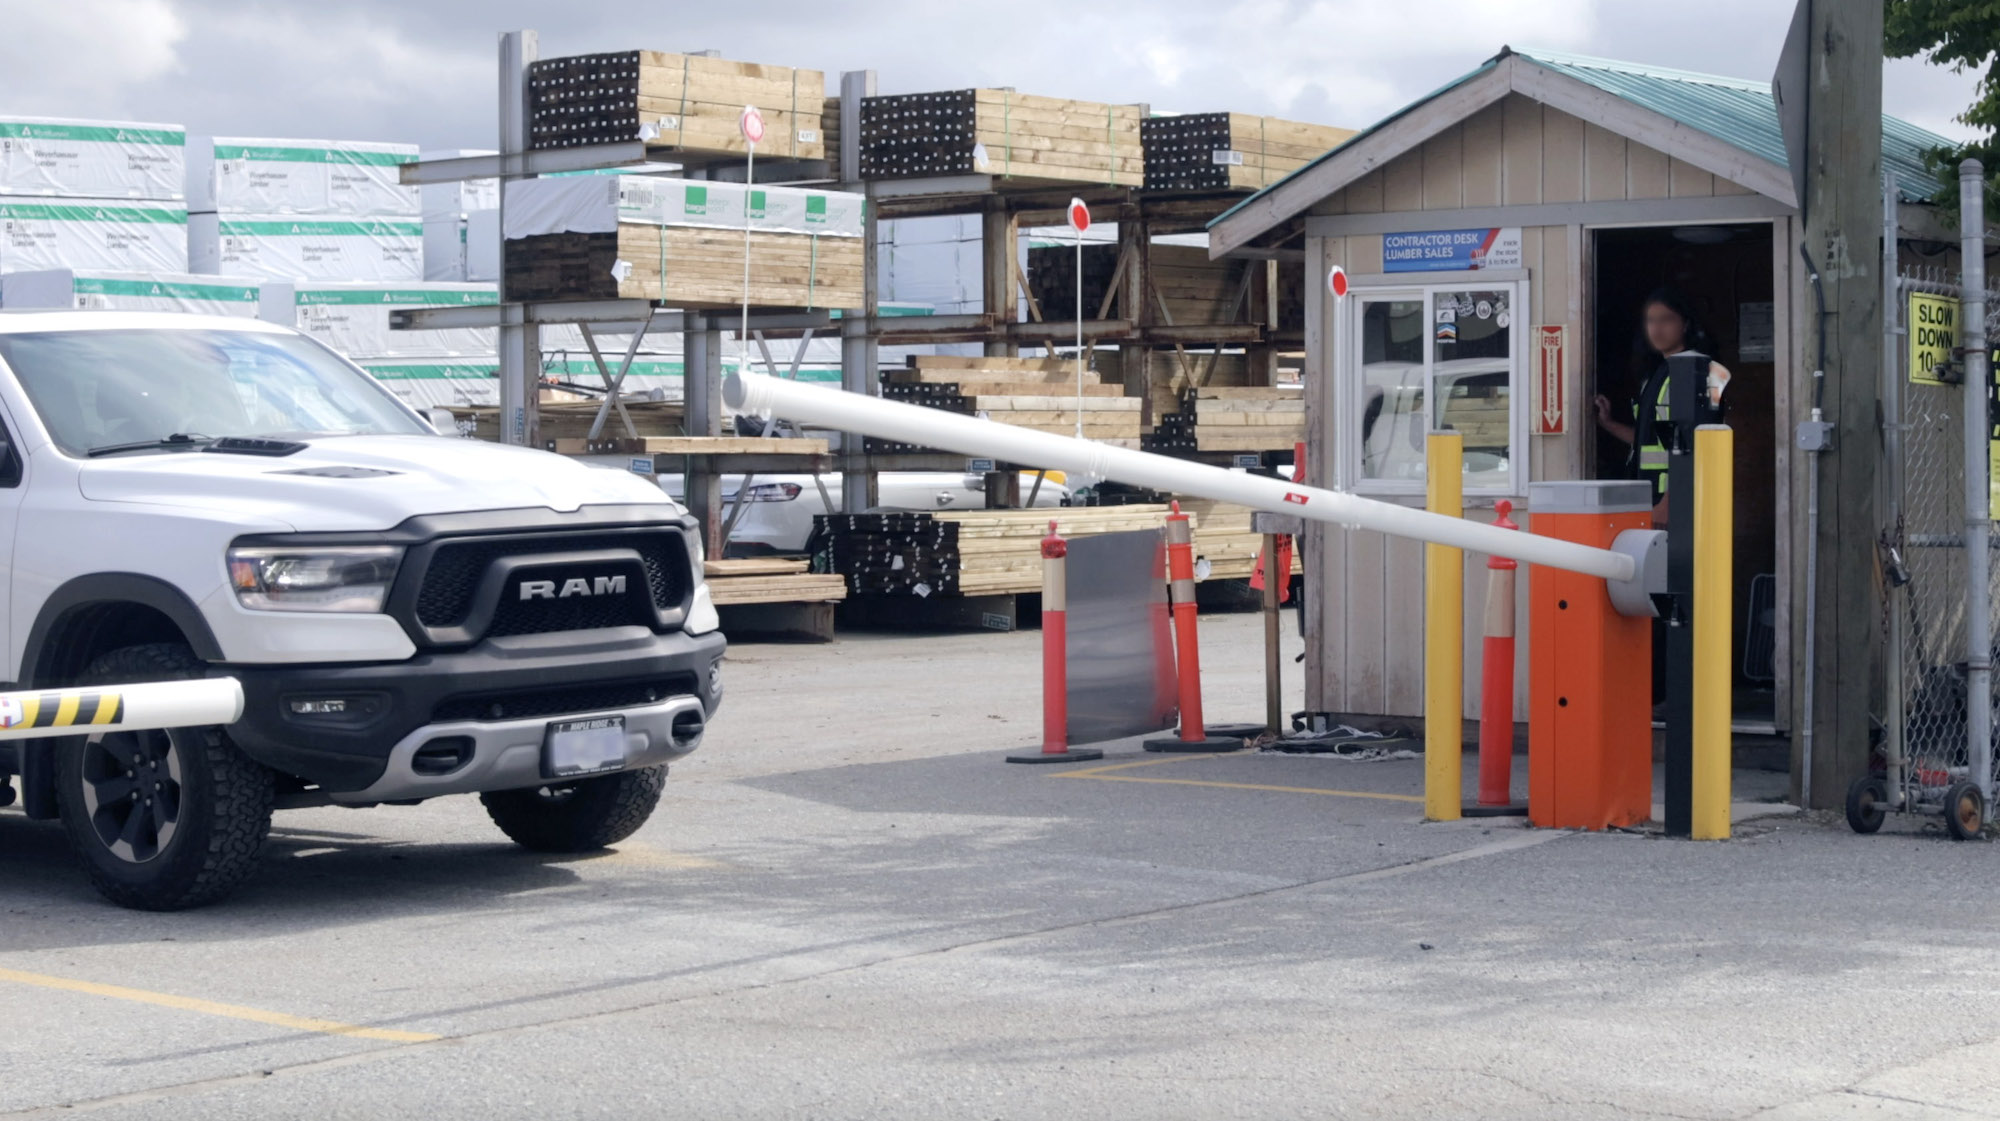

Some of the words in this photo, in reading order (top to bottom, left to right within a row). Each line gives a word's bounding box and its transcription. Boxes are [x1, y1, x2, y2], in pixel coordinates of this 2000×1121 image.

[1385, 234, 1452, 248] CONTRACTOR
[1454, 233, 1479, 245] DESK
[1385, 248, 1423, 260] LUMBER
[1425, 247, 1454, 258] SALES
[1919, 304, 1953, 327] SLOW
[1544, 336, 1559, 346] FIRE
[1918, 327, 1953, 349] DOWN
[519, 574, 627, 601] RAM
[570, 720, 590, 731] MAPLE
